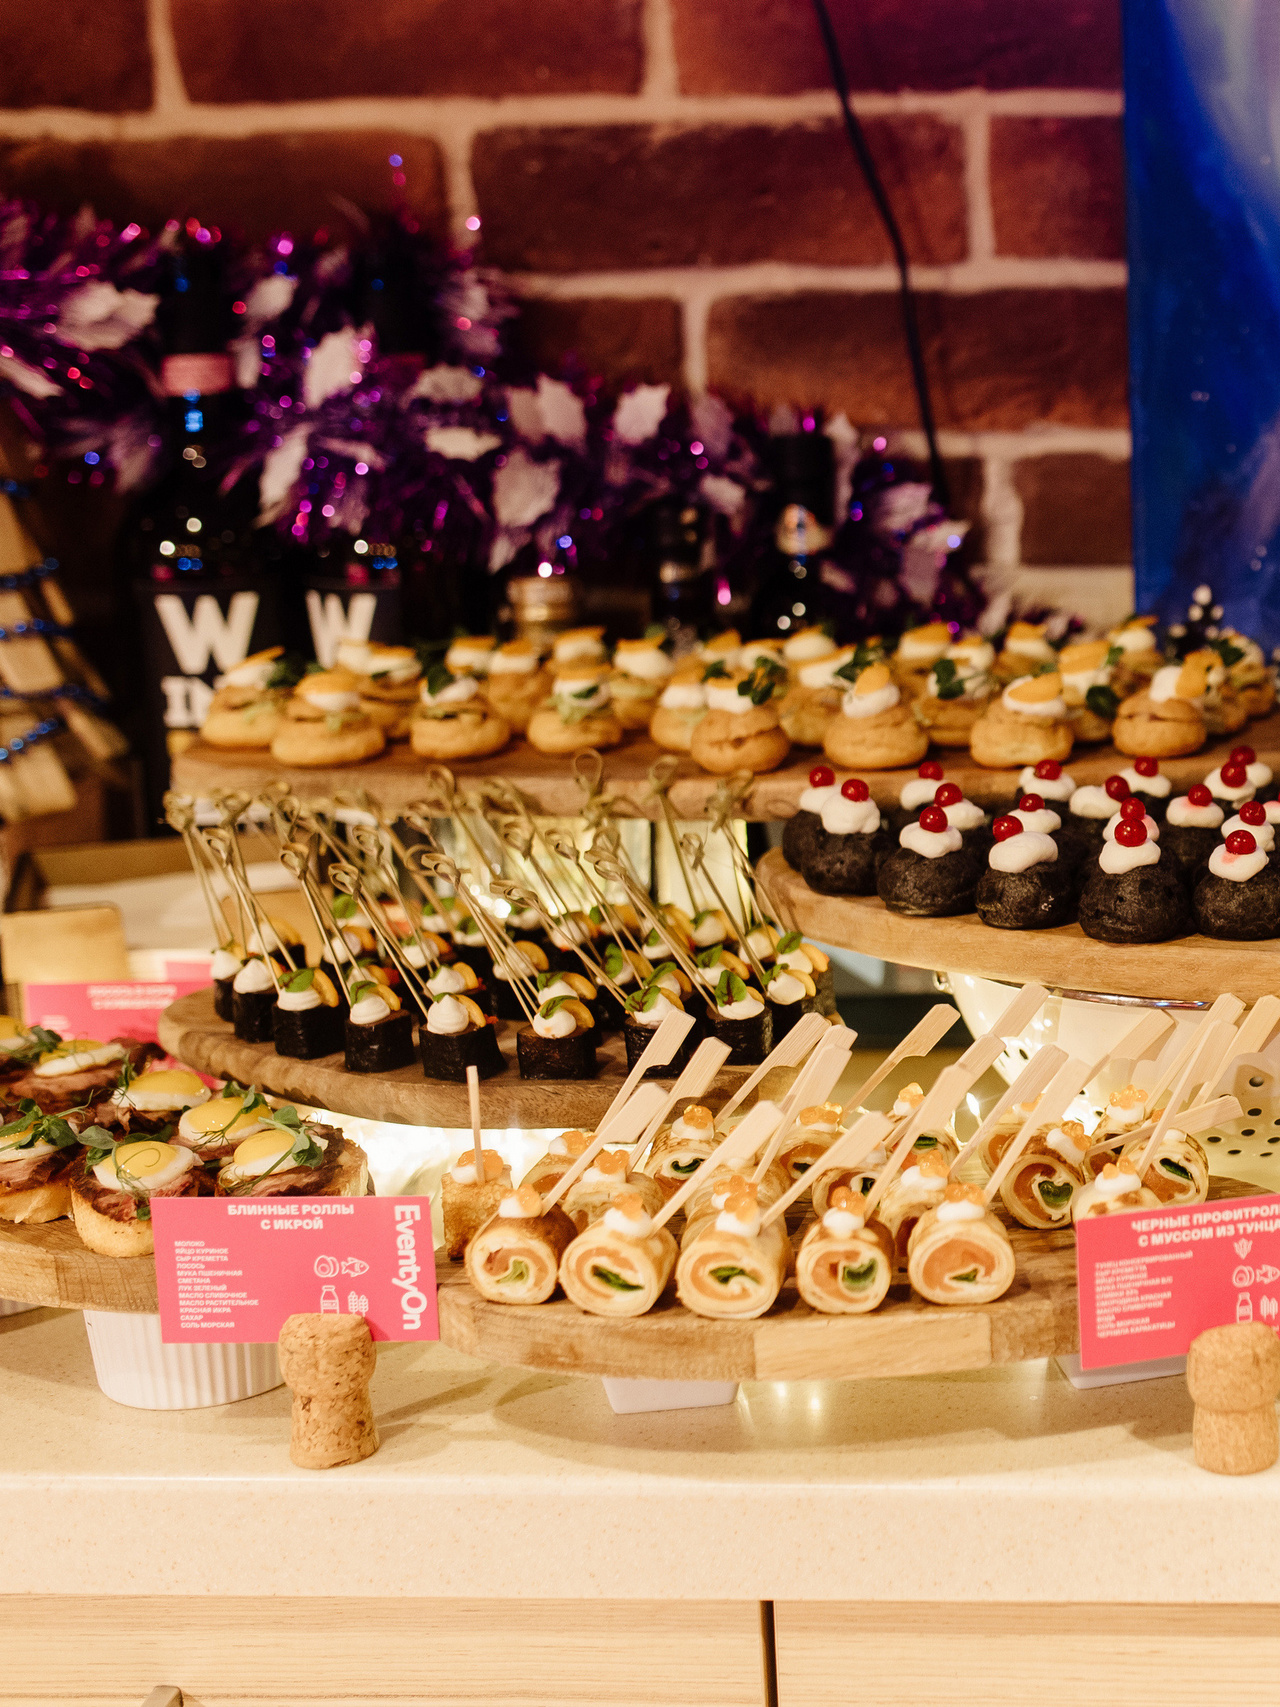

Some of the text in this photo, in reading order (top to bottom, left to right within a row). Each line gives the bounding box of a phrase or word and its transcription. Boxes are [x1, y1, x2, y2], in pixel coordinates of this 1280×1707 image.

[154, 591, 259, 675] W
[228, 1204, 354, 1215] БЛИННЫЕ РОЛЛЫ
[260, 1217, 323, 1230] С ИКРОЙ
[1131, 1214, 1191, 1233] ЧЕРНЫЕ
[1138, 1233, 1149, 1247] С
[1151, 1227, 1214, 1247] МУССОМ
[1216, 1225, 1235, 1238] ИЗ
[391, 1204, 428, 1330] EventyOn
